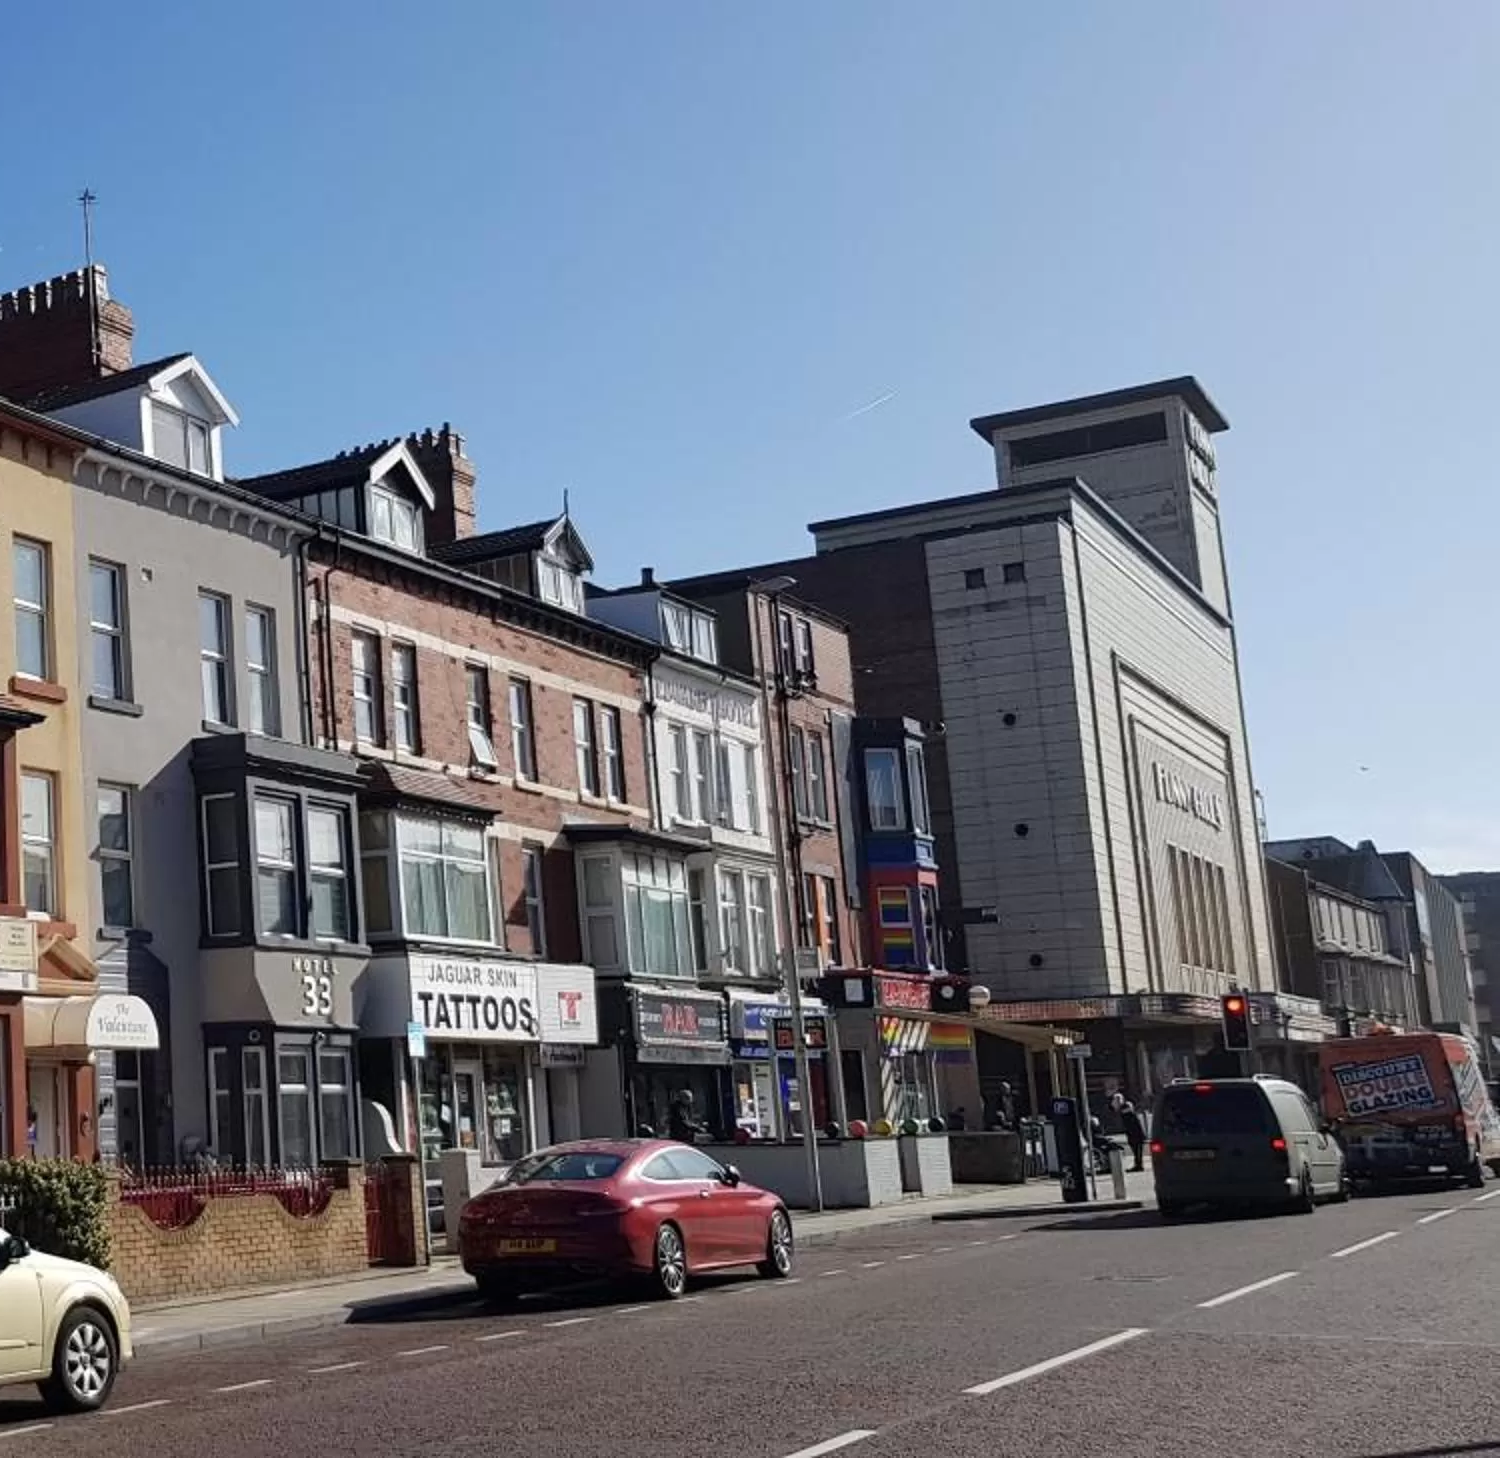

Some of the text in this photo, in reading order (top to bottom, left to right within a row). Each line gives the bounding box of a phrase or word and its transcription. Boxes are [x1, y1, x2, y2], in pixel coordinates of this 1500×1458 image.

[291, 957, 341, 976] HOTEL
[427, 963, 518, 988] JAGUAR SKIN
[301, 975, 333, 1016] 33
[417, 991, 536, 1035] TATTOOS
[661, 1003, 699, 1035] BAR
[1343, 1070, 1430, 1100] DOUBLE
[1348, 1085, 1434, 1115] GLAZING
